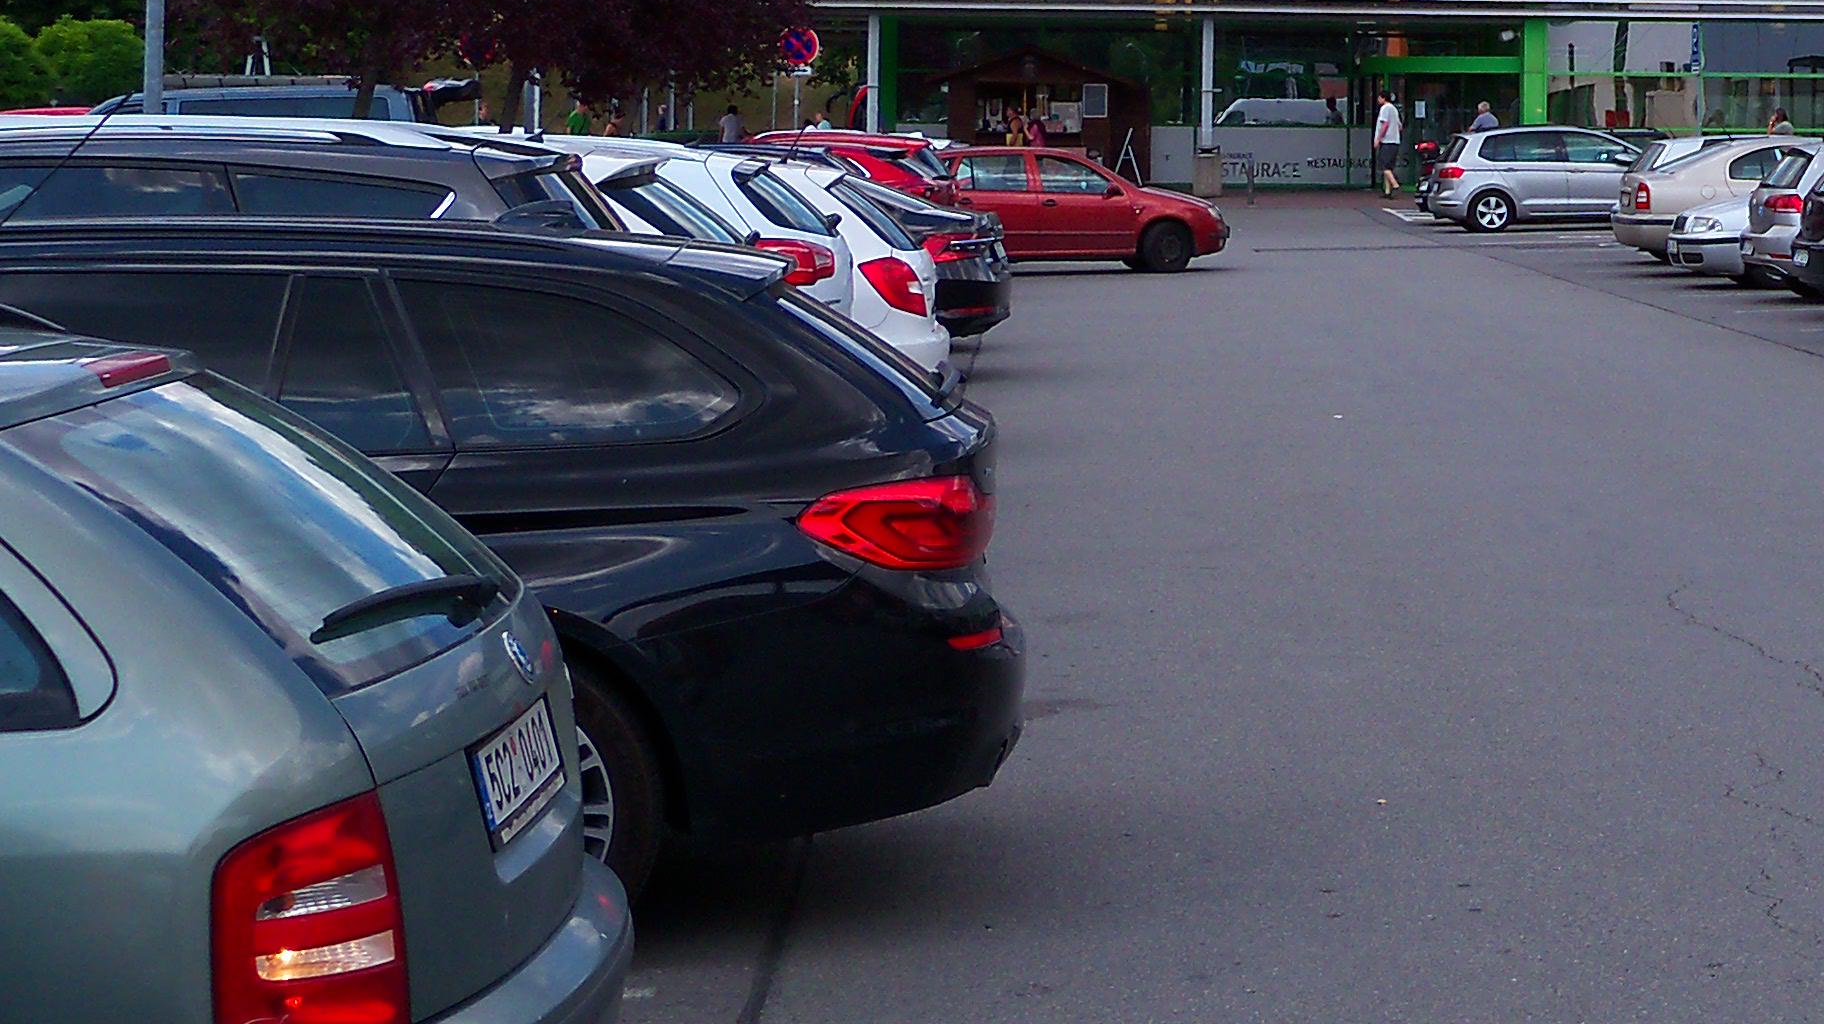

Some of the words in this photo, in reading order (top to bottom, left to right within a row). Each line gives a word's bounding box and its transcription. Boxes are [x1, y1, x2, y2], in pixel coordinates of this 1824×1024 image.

[1222, 162, 1302, 178] STAURACE
[484, 741, 521, 811] 5C2
[518, 710, 554, 782] 0401
